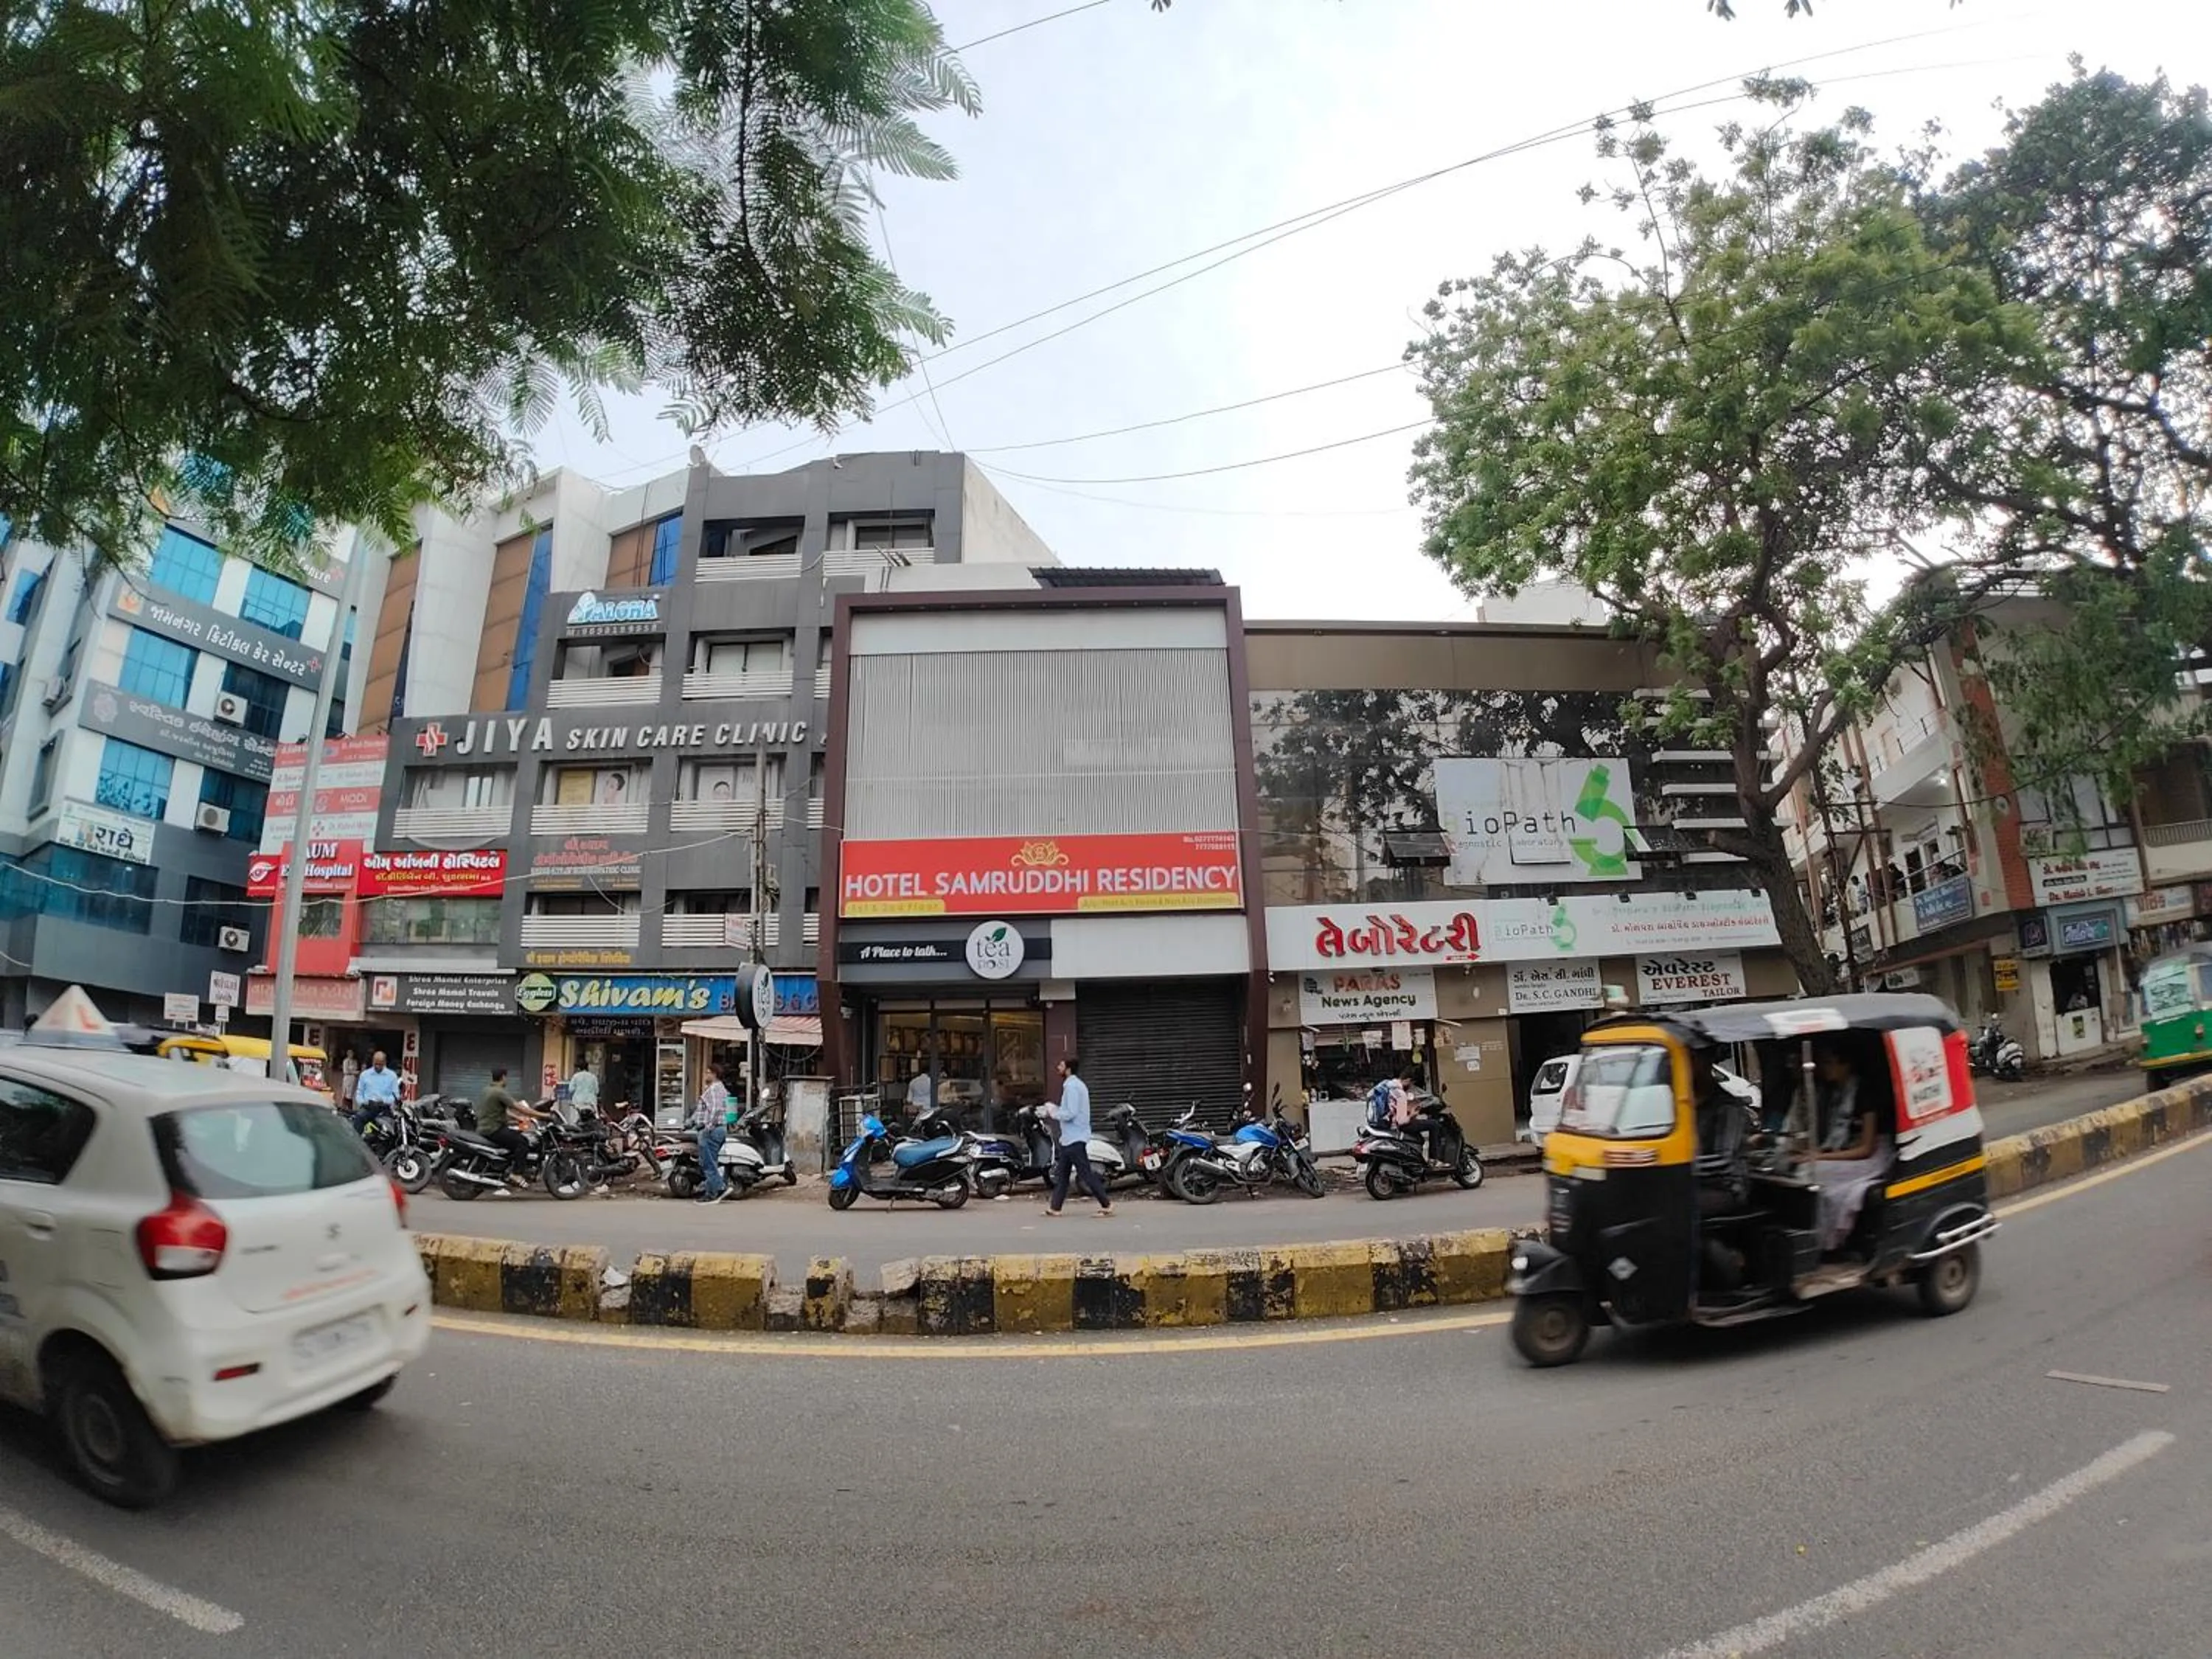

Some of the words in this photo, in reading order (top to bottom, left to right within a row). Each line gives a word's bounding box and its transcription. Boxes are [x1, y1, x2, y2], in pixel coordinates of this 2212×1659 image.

[150, 605, 201, 636] જામનગર
[253, 641, 269, 663] કેર
[456, 718, 553, 755] JIYA
[566, 727, 628, 750] SKIN
[637, 724, 706, 748] CARE
[714, 721, 807, 745] CLINIC
[305, 864, 353, 878] Hospital
[845, 872, 928, 898] HOTEL
[935, 869, 1089, 895] SAMRUDDHI
[1097, 865, 1237, 891] RESIDENCY
[860, 946, 871, 959] A
[872, 946, 901, 958] Place
[902, 945, 913, 957] to
[976, 938, 1011, 959] tea
[408, 975, 431, 984] Shree
[464, 975, 508, 986] Enterprise
[1333, 973, 1401, 993] PARAS
[1652, 973, 1731, 990] EVEREST
[413, 987, 436, 996] Shree
[468, 988, 499, 997] Travels
[516, 987, 553, 1001] Eggless
[557, 978, 711, 1010] Shivam's
[1554, 987, 1596, 998] GANDHI
[1702, 987, 1741, 998] TAILOR
[406, 998, 436, 1008] Foreign
[437, 1000, 465, 1009] Money
[467, 1001, 506, 1010] Exchange
[1321, 996, 1359, 1008] News
[1363, 994, 1416, 1008] Agency
